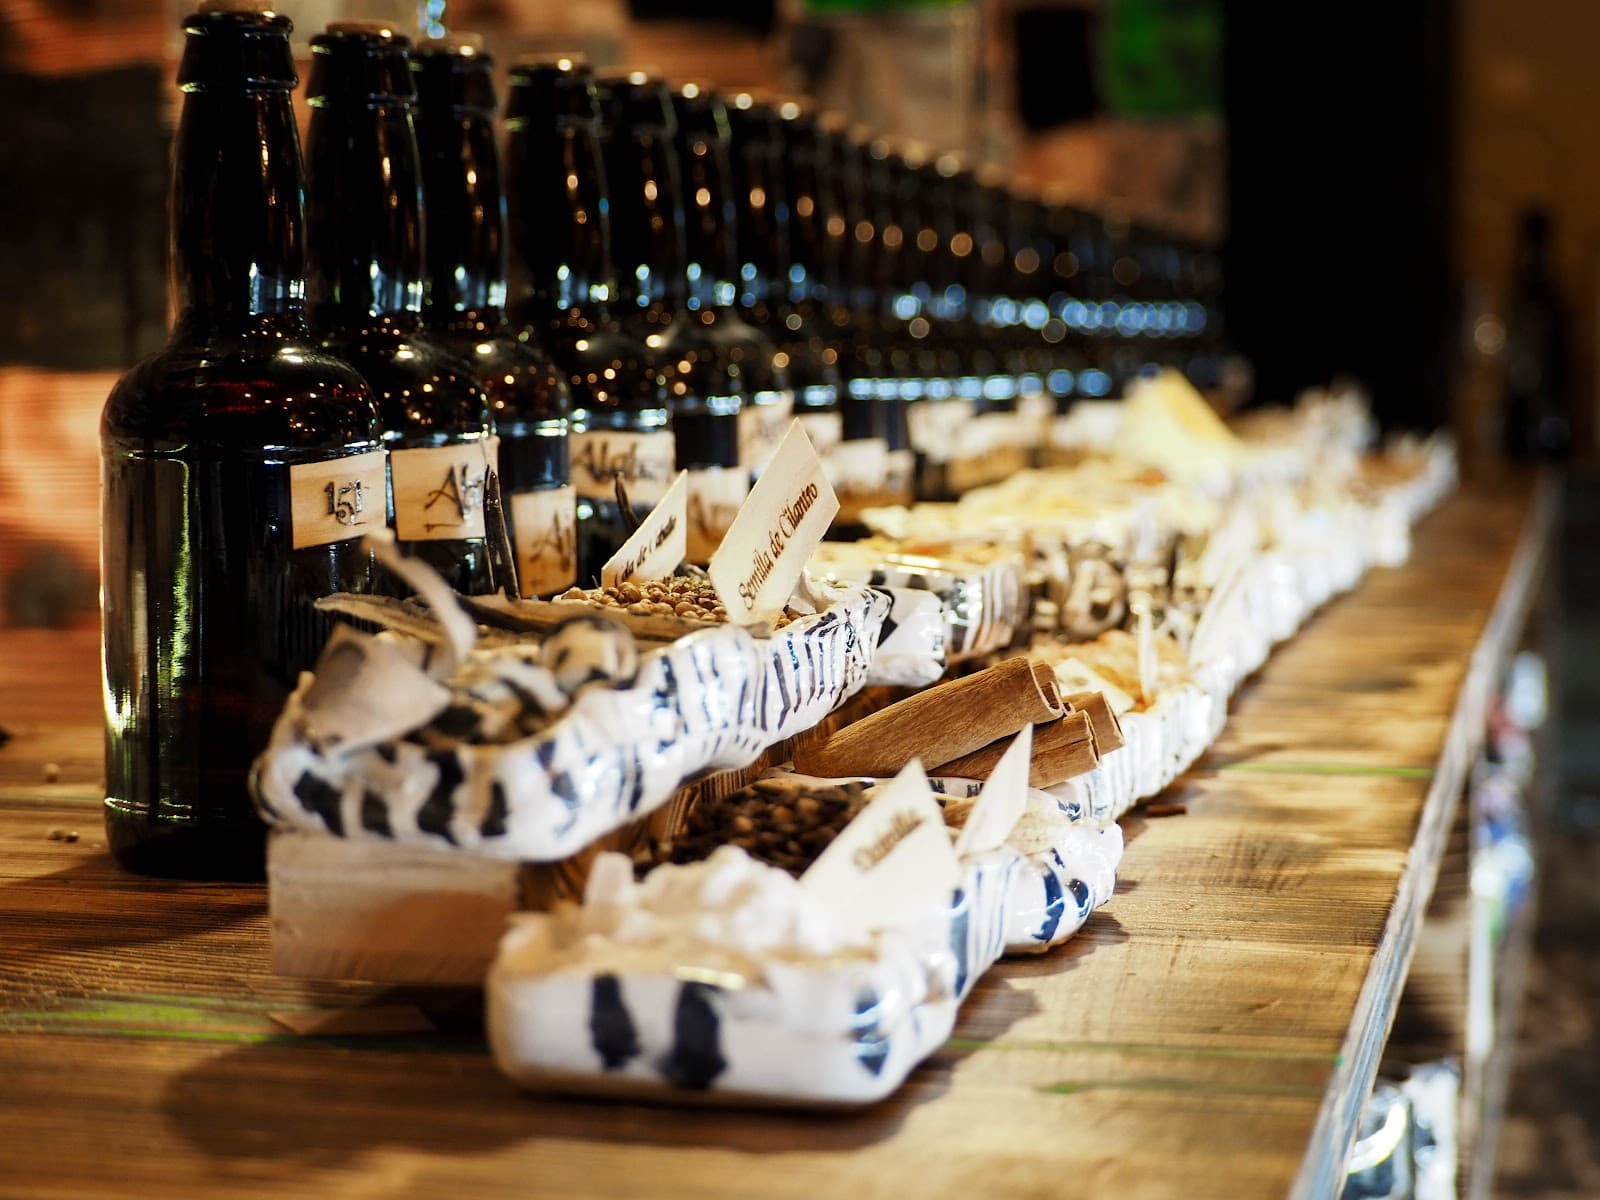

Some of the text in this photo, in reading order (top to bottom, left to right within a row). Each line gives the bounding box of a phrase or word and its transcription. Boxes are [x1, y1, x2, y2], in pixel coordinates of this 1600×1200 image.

[738, 482, 818, 610] Semilla de Cilantro
